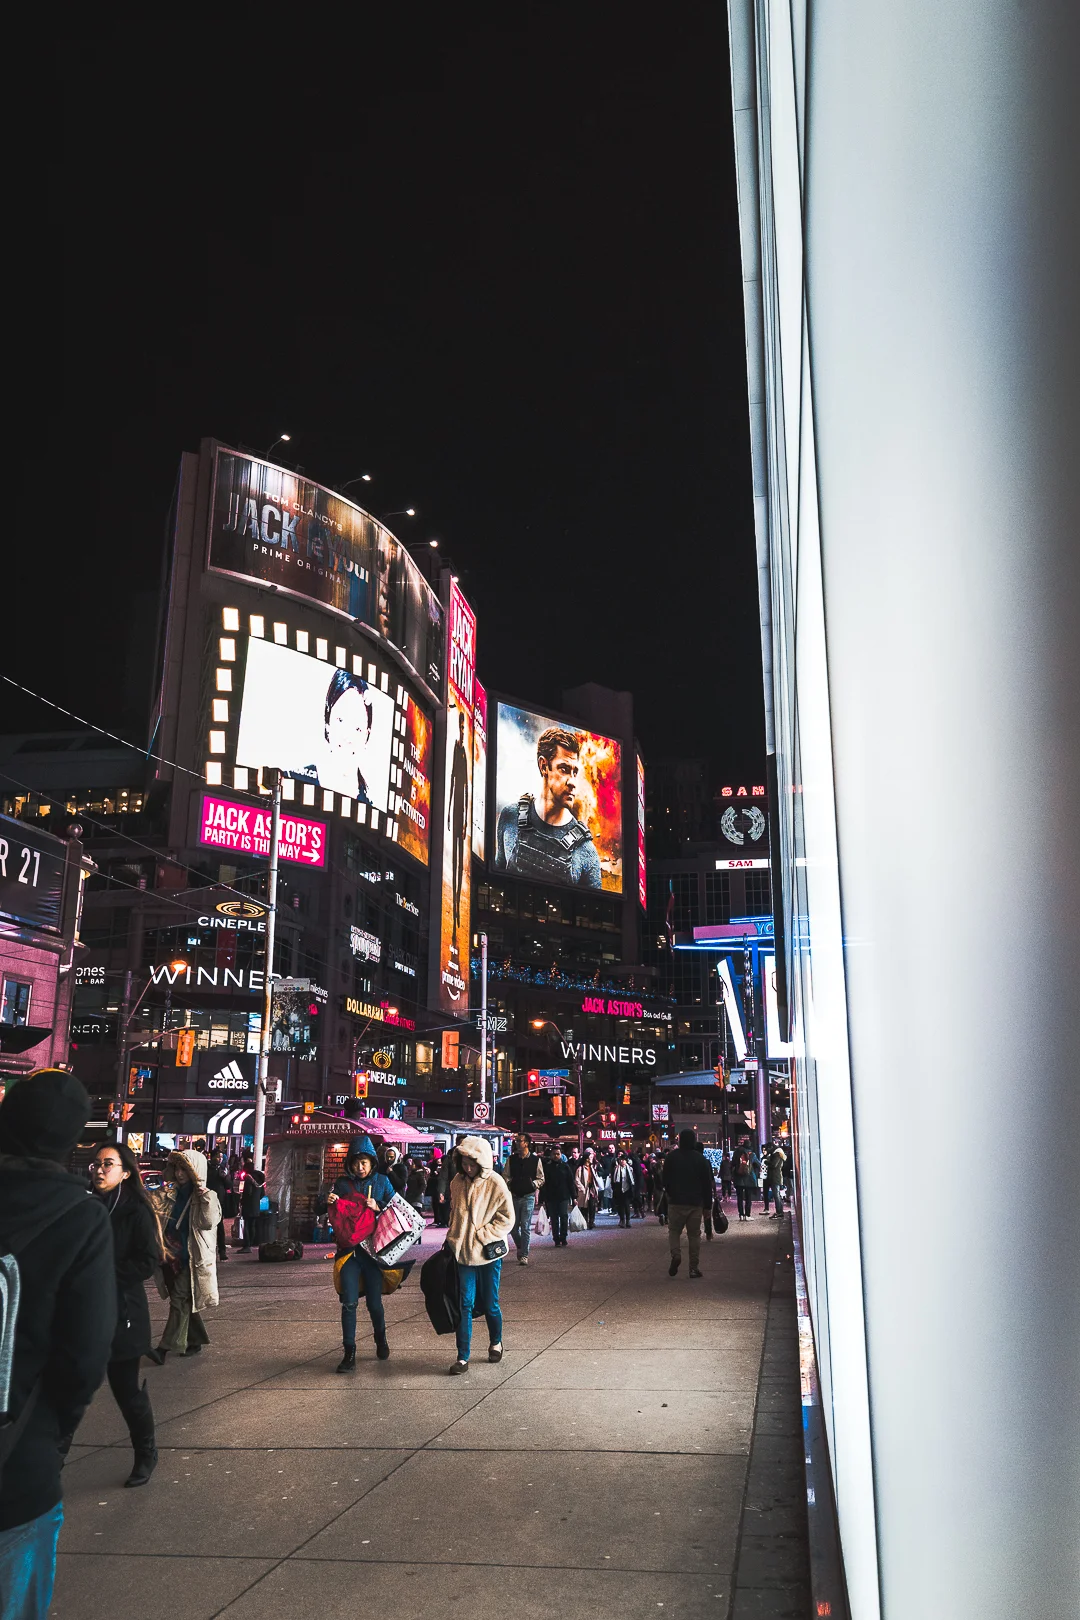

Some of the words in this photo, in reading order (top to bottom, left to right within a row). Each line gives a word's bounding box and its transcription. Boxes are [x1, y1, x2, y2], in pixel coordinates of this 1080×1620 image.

[223, 492, 300, 554] JACK
[263, 491, 289, 507] TOM
[293, 503, 343, 532] CLANCY'S
[253, 543, 291, 563] PRIME
[297, 559, 347, 587] ORIGINAL
[451, 598, 473, 666] JACK
[450, 638, 473, 706] RYAN
[721, 785, 765, 797] SAM
[205, 802, 250, 834] JACK
[253, 813, 322, 849] ASTOR'S
[204, 827, 239, 847] PARTY
[241, 834, 251, 850] IS
[253, 837, 271, 854] THI
[278, 842, 301, 860] WAY
[18, 847, 40, 888] 21
[728, 860, 753, 868] SAM
[149, 965, 293, 990] WINNE
[346, 997, 384, 1022] DOLLARAMA
[581, 996, 605, 1014] JACK
[607, 999, 643, 1018] ASTOR'S
[560, 1041, 657, 1066] WINNERS
[207, 1078, 249, 1090] adidas
[366, 1069, 396, 1086] CINEPLEX
